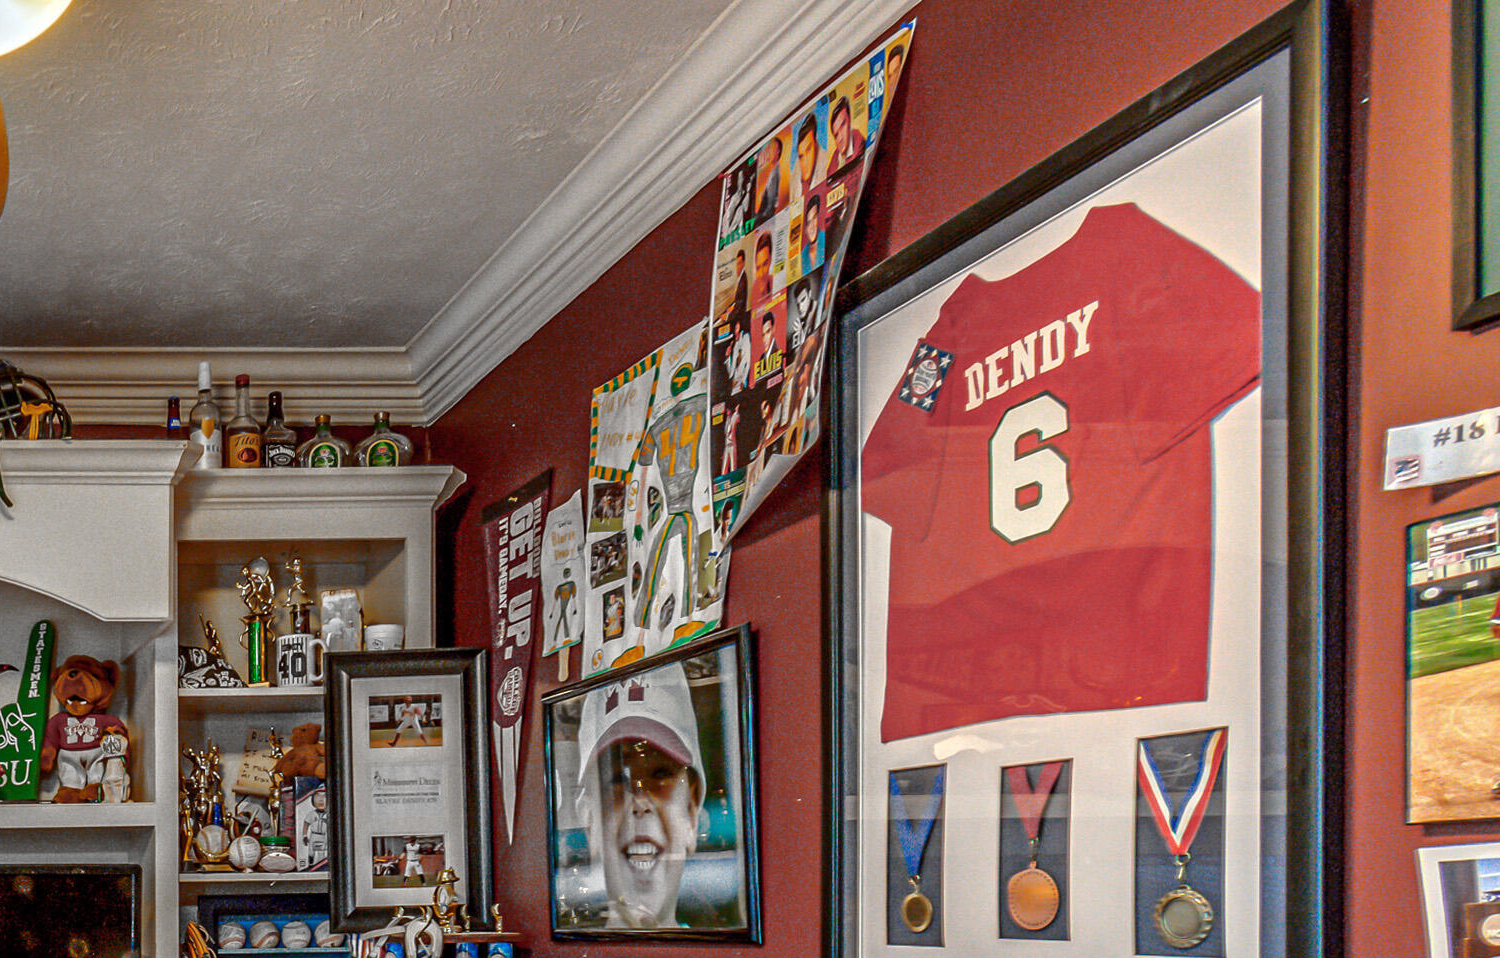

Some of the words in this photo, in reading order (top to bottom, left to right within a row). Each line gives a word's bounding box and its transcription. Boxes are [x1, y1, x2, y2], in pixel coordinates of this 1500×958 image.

[753, 349, 783, 380] ELVIS
[963, 300, 1099, 412] DENDY
[988, 390, 1073, 545] 6
[1432, 420, 1486, 448] #18
[508, 501, 534, 581] GET
[28, 622, 47, 698] STATESMEN
[278, 652, 307, 679] 40
